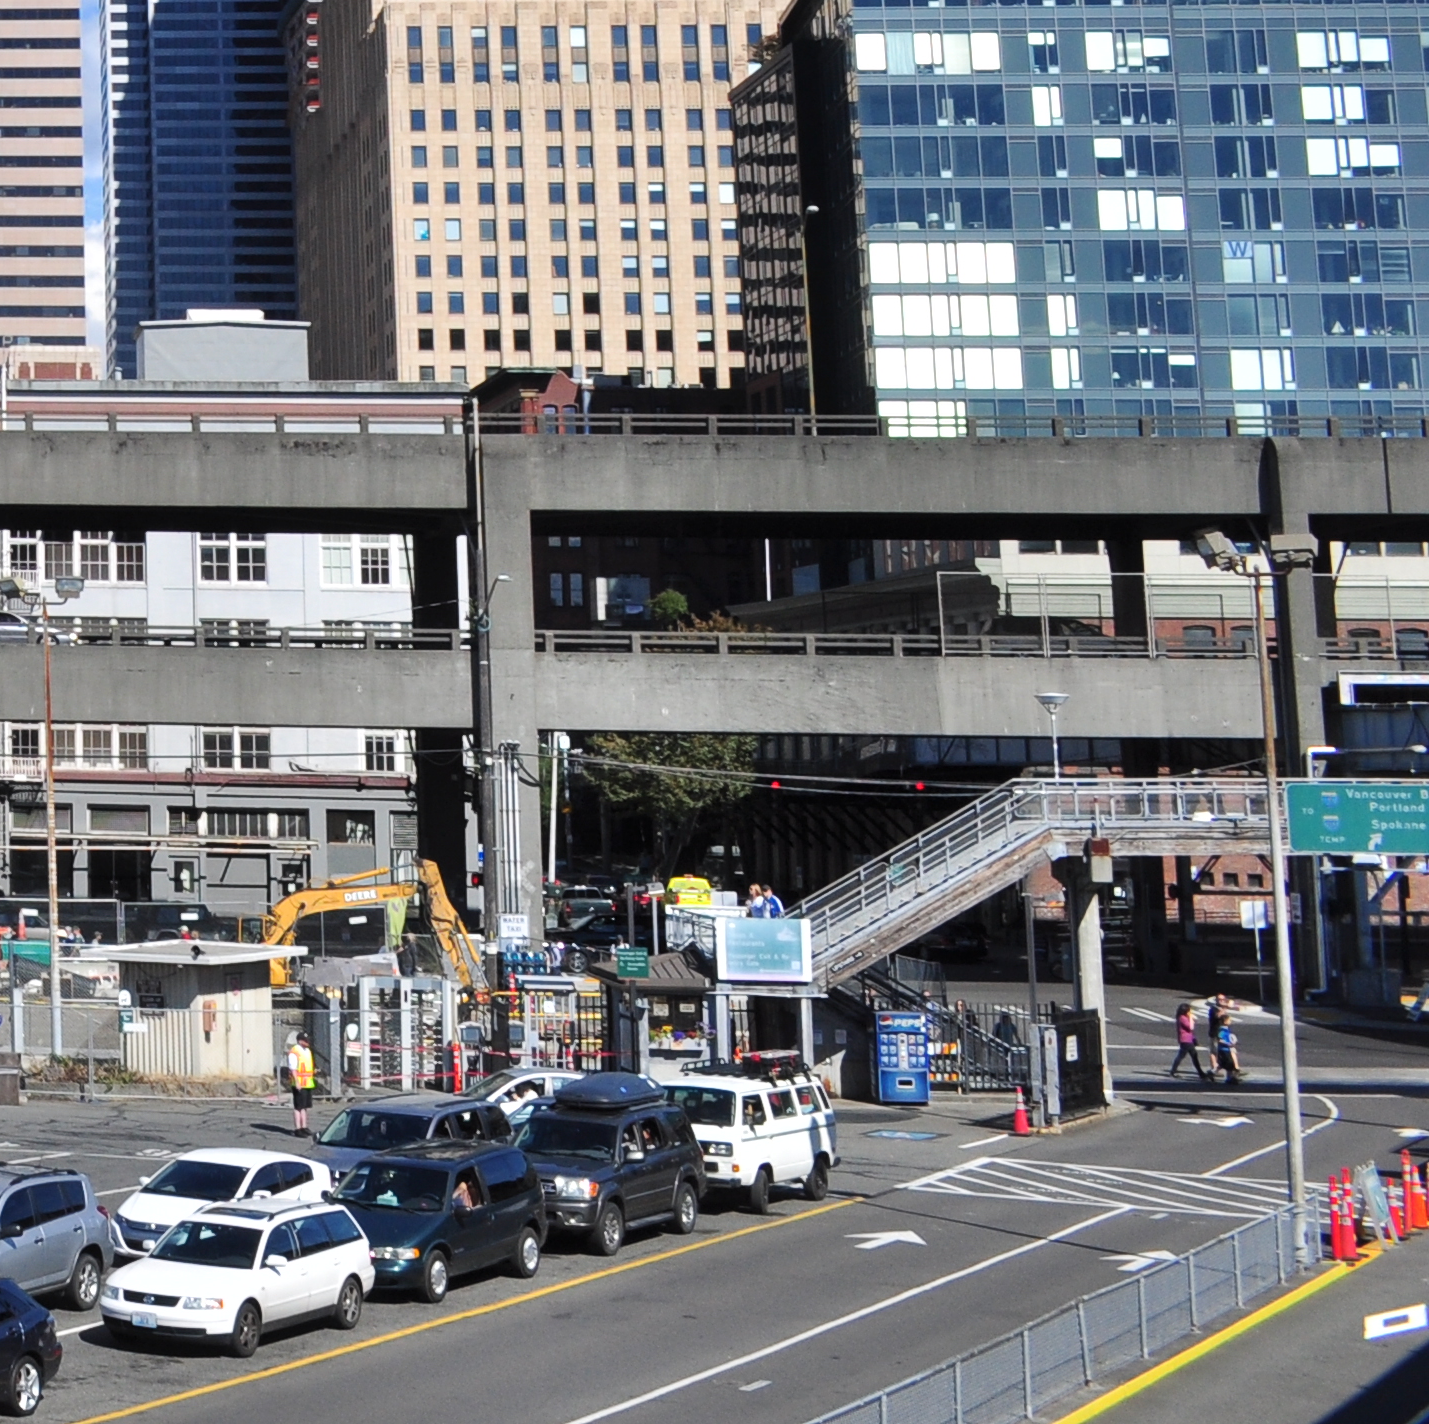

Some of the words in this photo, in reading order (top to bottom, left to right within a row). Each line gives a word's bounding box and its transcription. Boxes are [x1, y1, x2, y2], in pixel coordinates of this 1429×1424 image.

[1227, 241, 1248, 257] W
[1345, 788, 1413, 800] Vancouver
[1302, 807, 1314, 815] TO
[1369, 801, 1426, 813] Portland
[1371, 819, 1427, 832] Spokane
[1319, 835, 1346, 844] TEMP
[343, 889, 377, 903] DEERE
